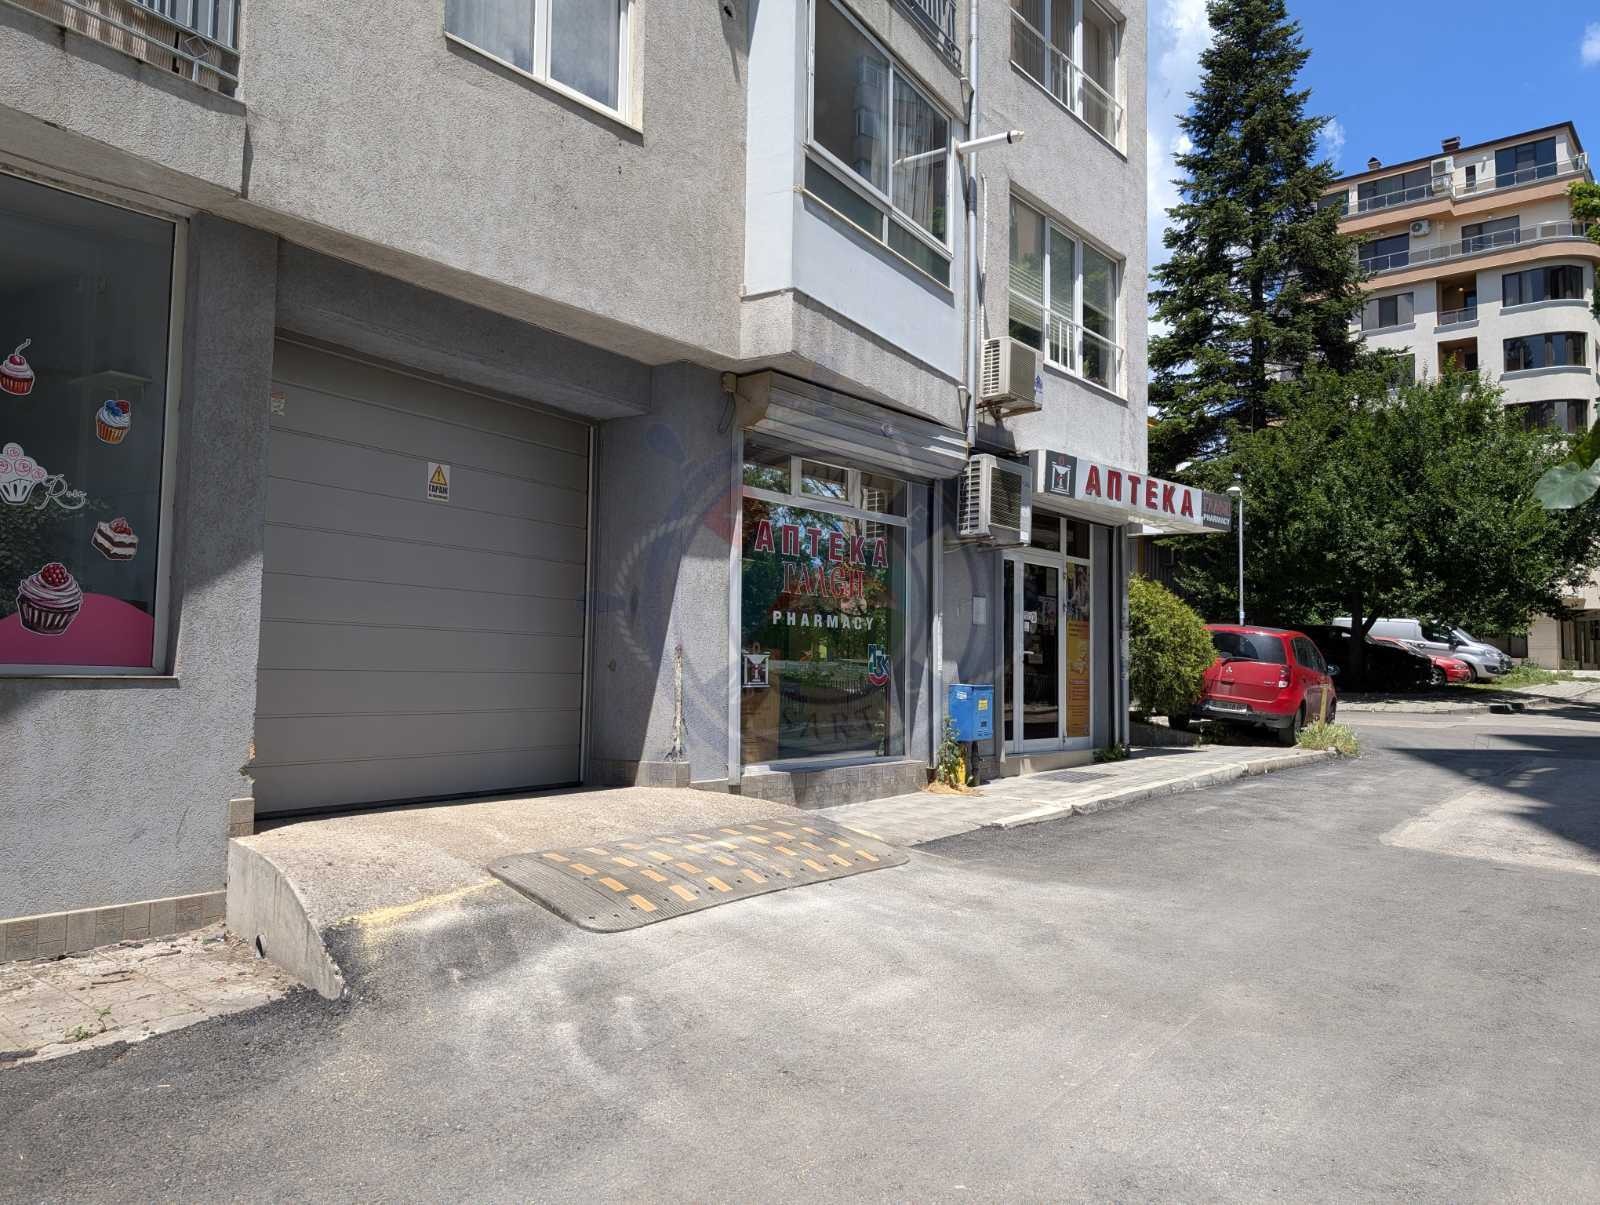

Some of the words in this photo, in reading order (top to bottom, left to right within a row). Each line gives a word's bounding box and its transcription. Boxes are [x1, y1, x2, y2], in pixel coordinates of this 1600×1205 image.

[1085, 464, 1195, 519] АПТЕКА
[754, 519, 889, 568] АПТЕКА
[772, 610, 874, 631] PHARMACY
